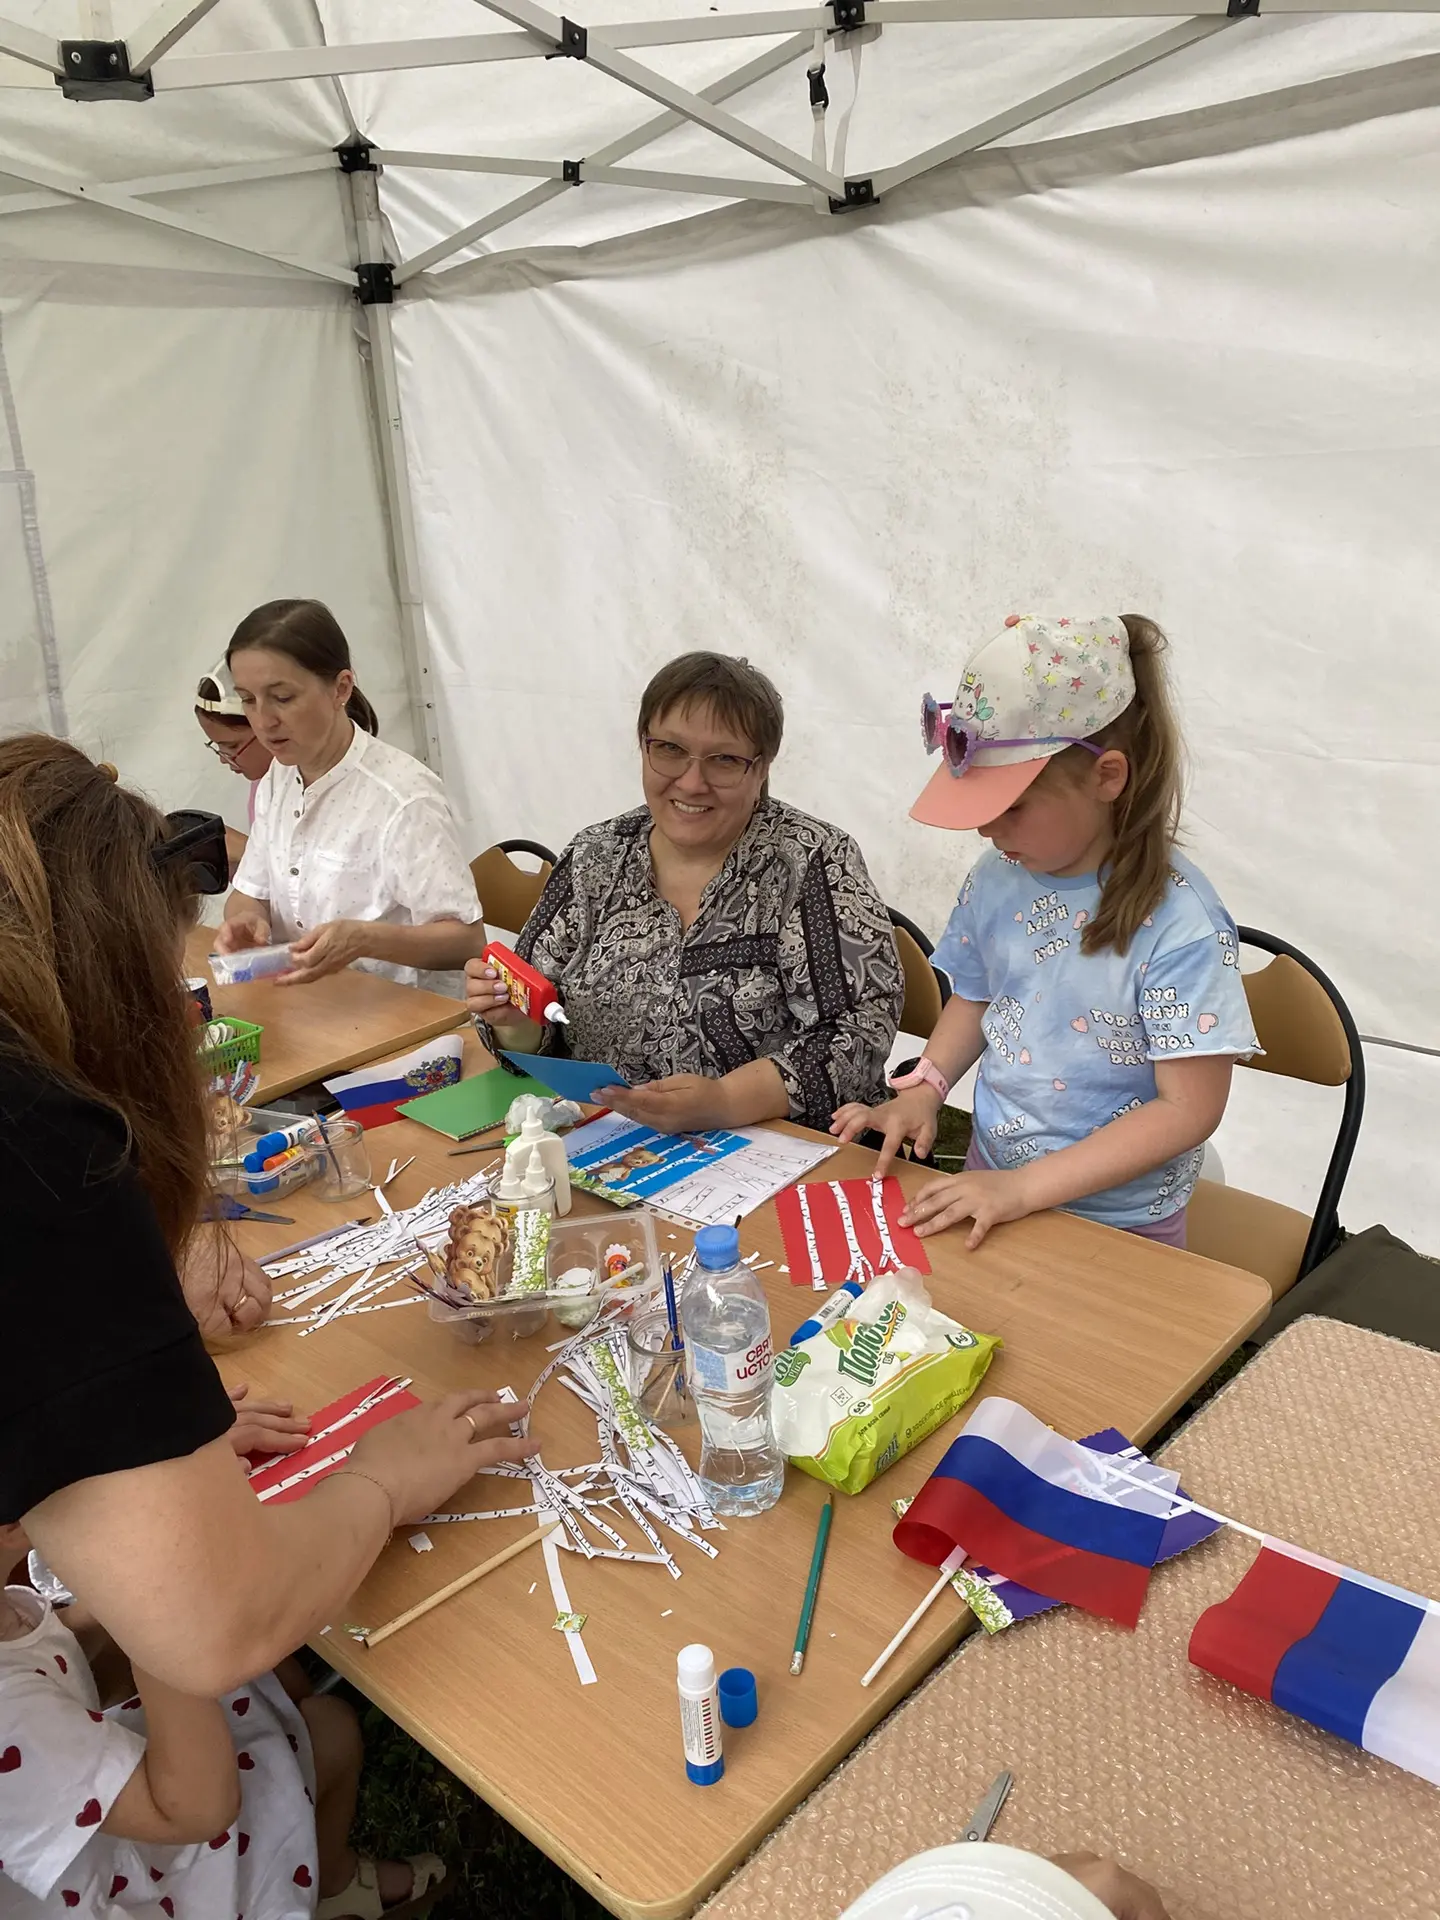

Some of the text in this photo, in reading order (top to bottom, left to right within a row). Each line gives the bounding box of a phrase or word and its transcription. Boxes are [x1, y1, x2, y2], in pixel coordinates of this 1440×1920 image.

[1144, 986, 1177, 1002] DAY
[1090, 1008, 1141, 1028] TODA
[988, 1113, 1026, 1139] TODAY
[736, 1352, 773, 1380] ИСТО
